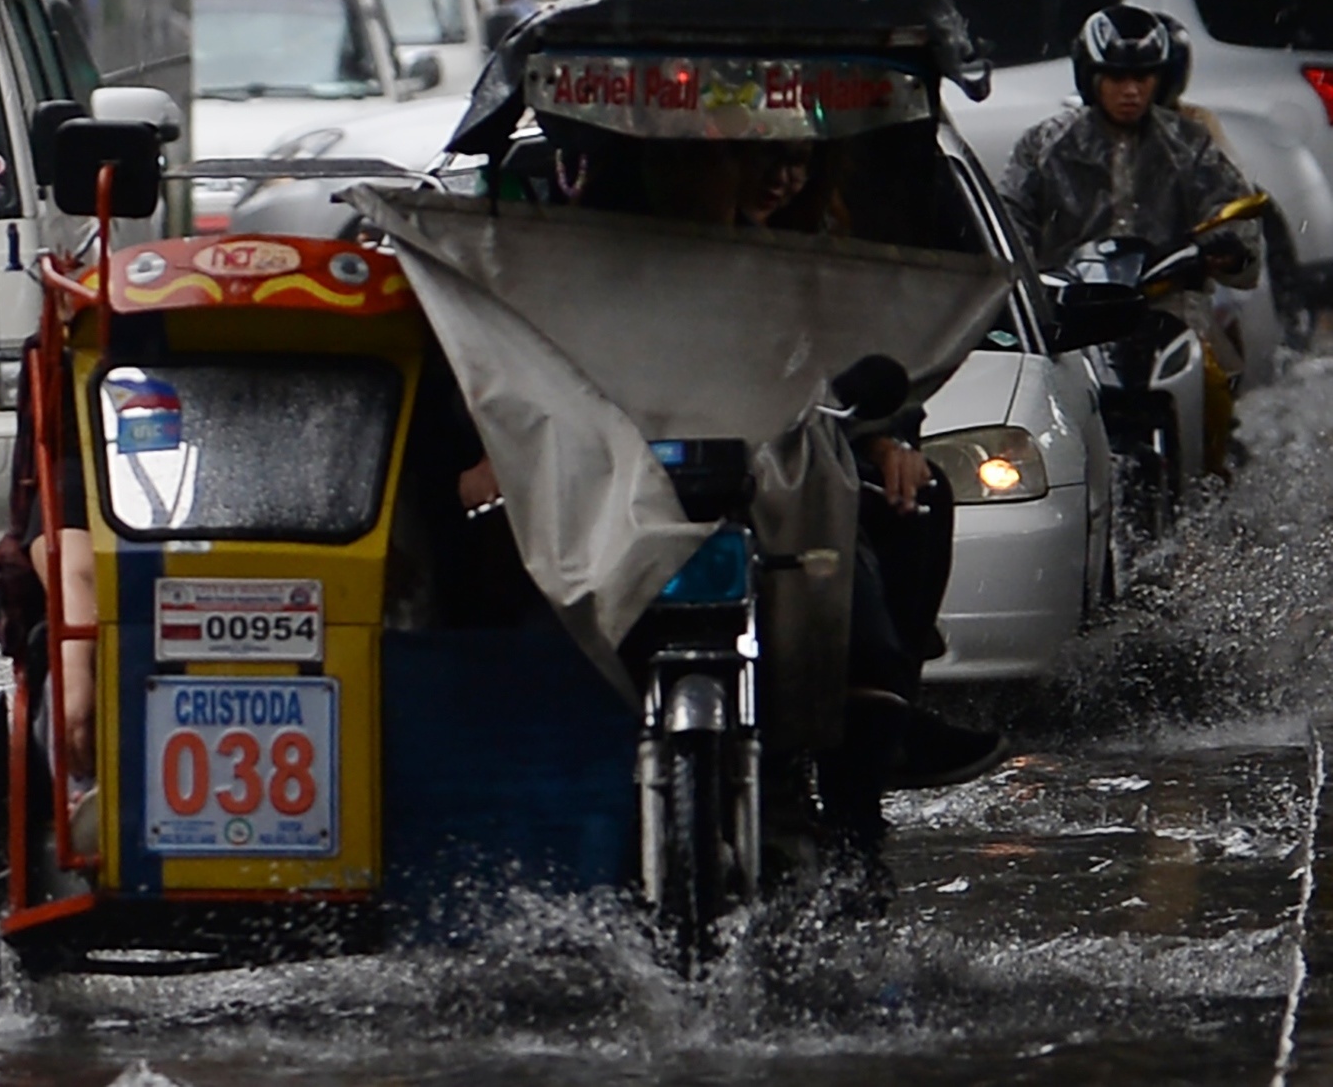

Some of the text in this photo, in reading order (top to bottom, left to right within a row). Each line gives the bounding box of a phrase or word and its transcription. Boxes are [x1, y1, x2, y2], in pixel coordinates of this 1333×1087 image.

[554, 64, 637, 106] Adriel
[206, 615, 315, 641] 00954
[175, 688, 304, 726] CRISTODA
[161, 729, 317, 818] 038
